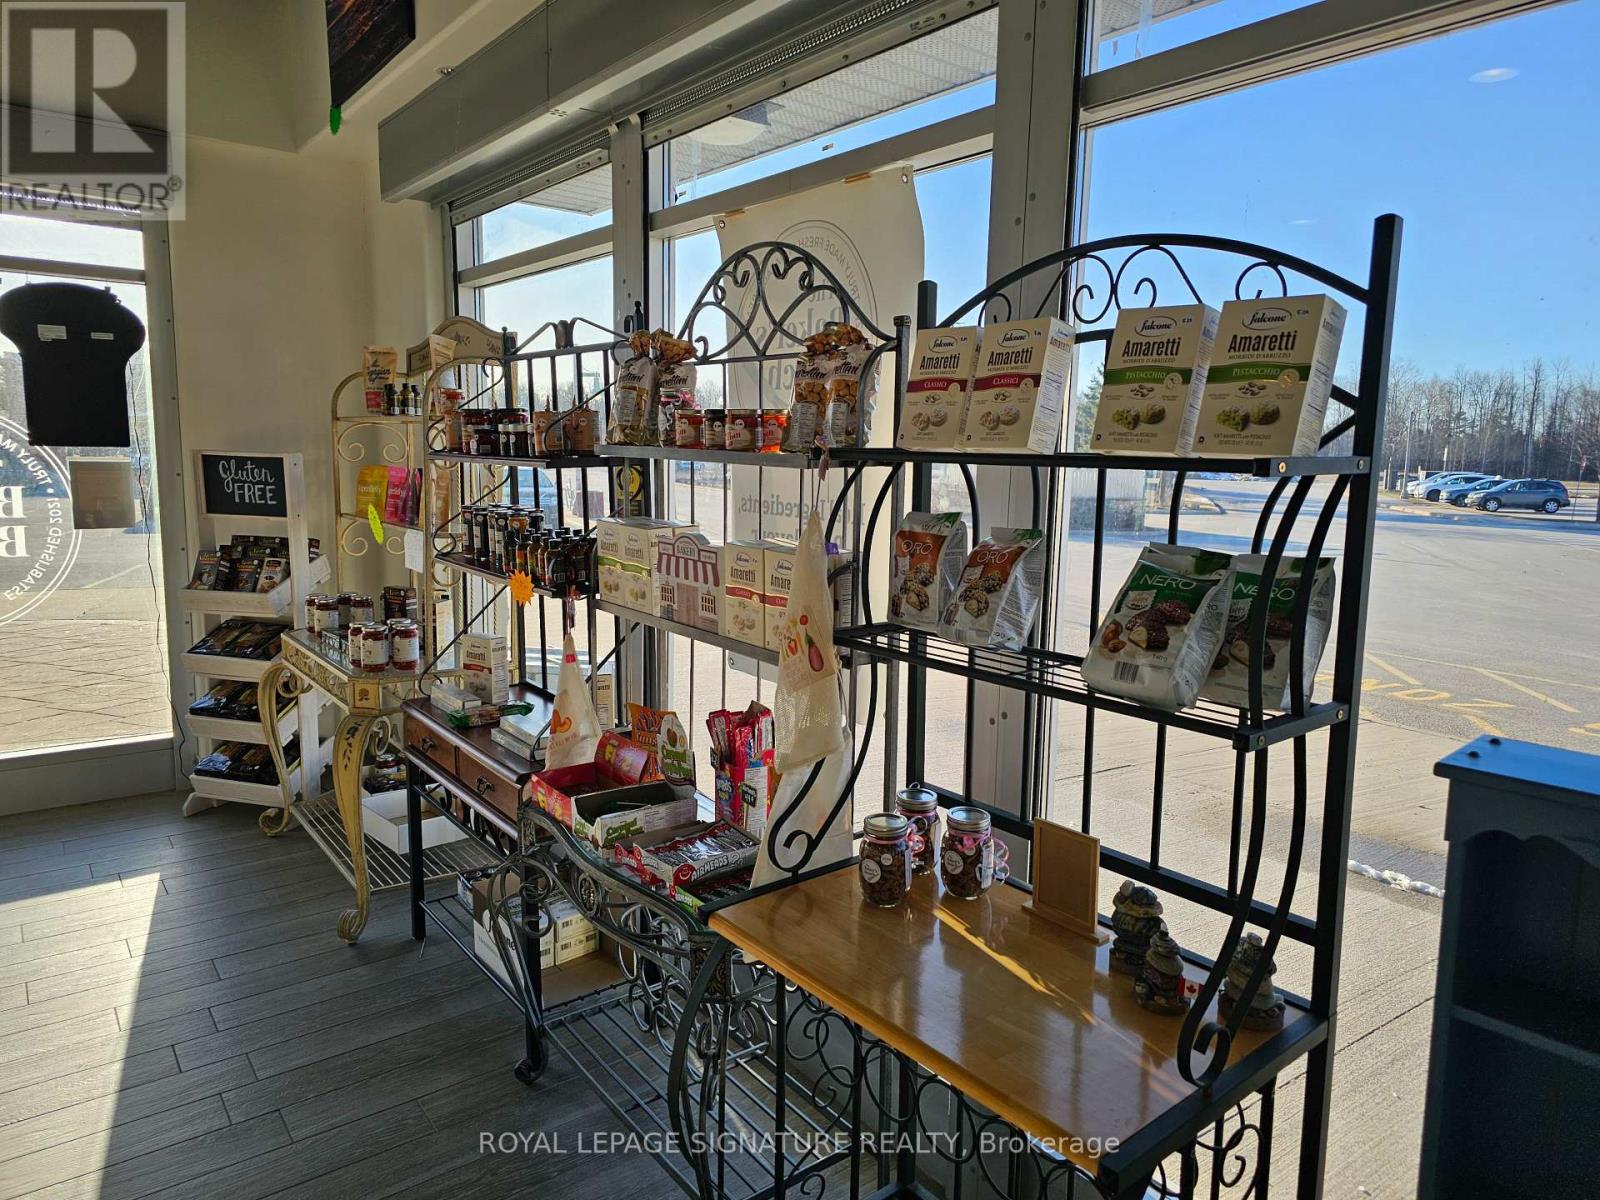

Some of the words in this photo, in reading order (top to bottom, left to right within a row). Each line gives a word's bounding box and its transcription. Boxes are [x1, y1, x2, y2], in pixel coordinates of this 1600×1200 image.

[1122, 337, 1182, 357] Amaretti
[1228, 330, 1298, 353] Amaretti
[920, 352, 961, 370] Amaretti
[988, 346, 1034, 367] Amaretti
[234, 482, 277, 505] FREE
[902, 540, 934, 555] ORO
[977, 550, 1009, 565] ORO
[1140, 573, 1198, 590] NERO
[691, 854, 729, 883] AIRHEADS
